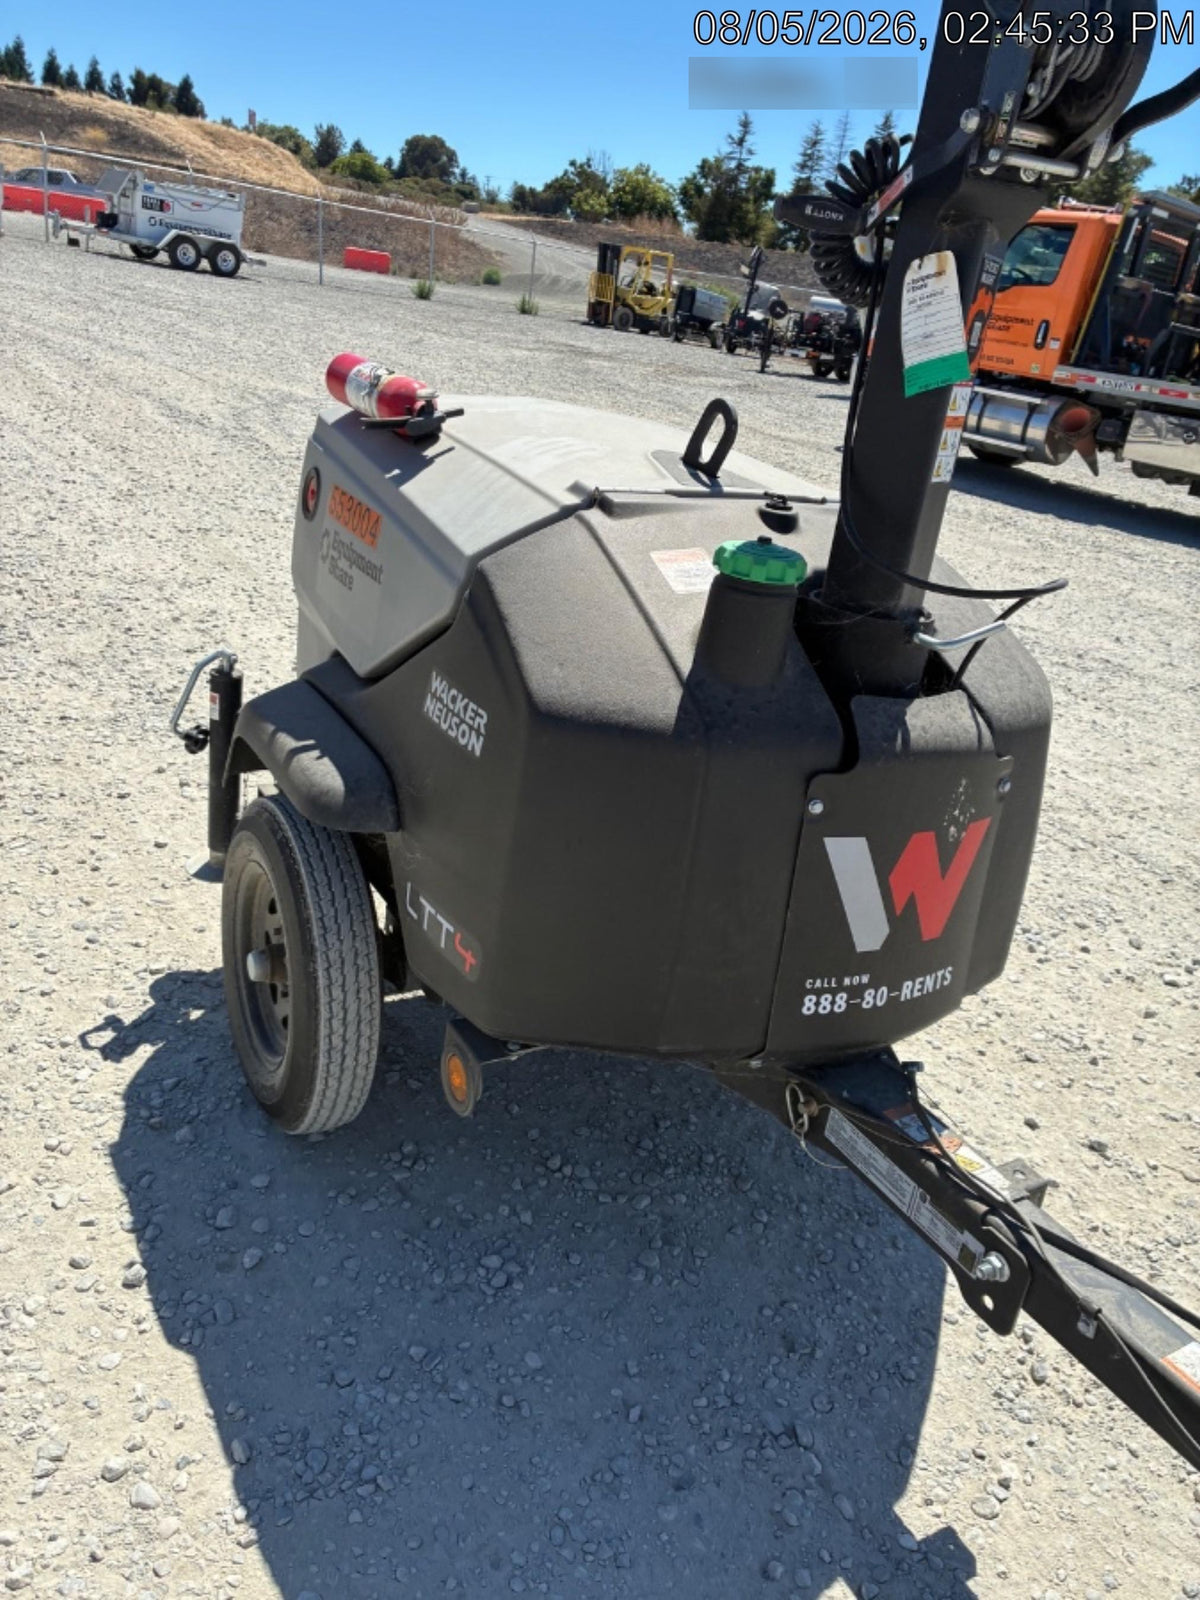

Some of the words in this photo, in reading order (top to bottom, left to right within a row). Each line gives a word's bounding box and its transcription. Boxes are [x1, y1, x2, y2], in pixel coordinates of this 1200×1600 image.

[331, 530, 384, 585] Equipment
[423, 693, 485, 757] NEUSON
[430, 671, 488, 735] WACKER
[406, 881, 477, 974] LTT4
[801, 966, 953, 1016] 888-80-RENTS
[805, 977, 838, 989] CALL
[843, 973, 871, 986] NOW
